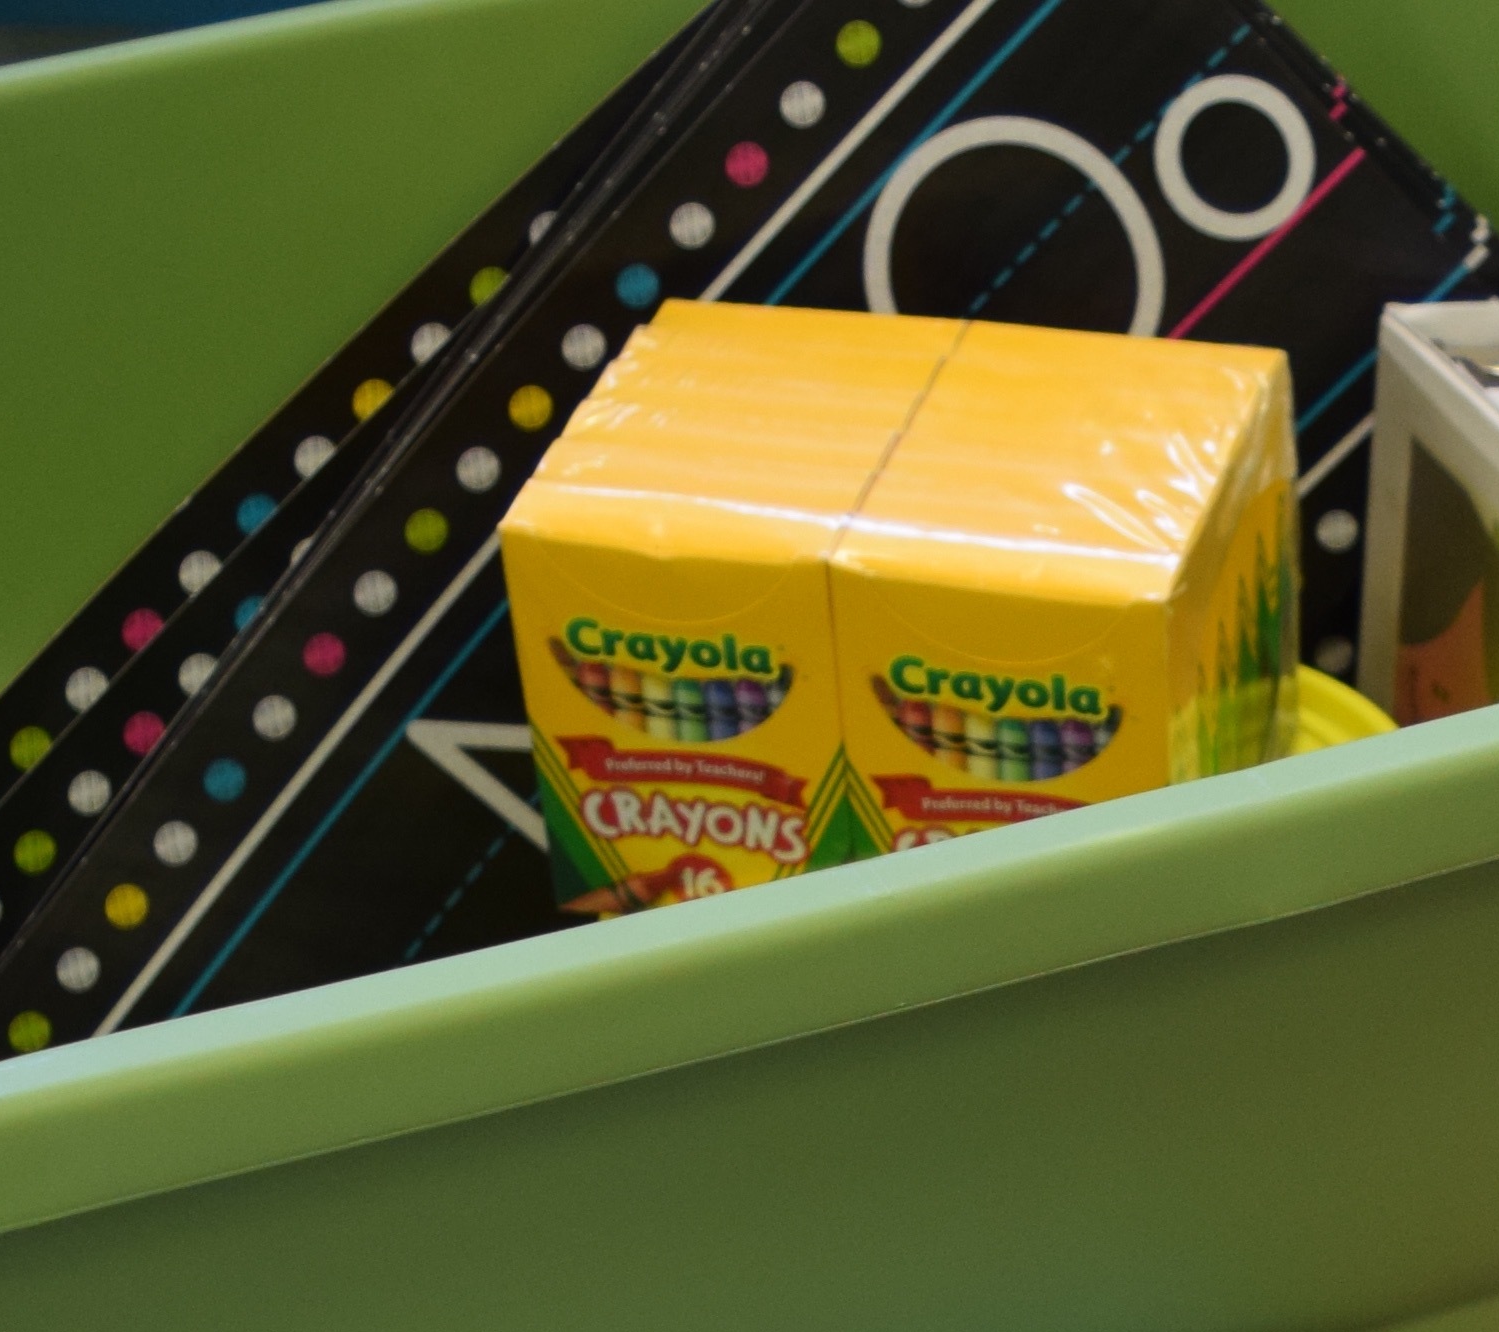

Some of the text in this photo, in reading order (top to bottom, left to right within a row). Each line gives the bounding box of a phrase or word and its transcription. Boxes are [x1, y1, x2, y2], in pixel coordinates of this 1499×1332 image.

[566, 616, 773, 676] Crayola
[889, 654, 1102, 716] Crayola
[583, 788, 808, 863] CRAYONS
